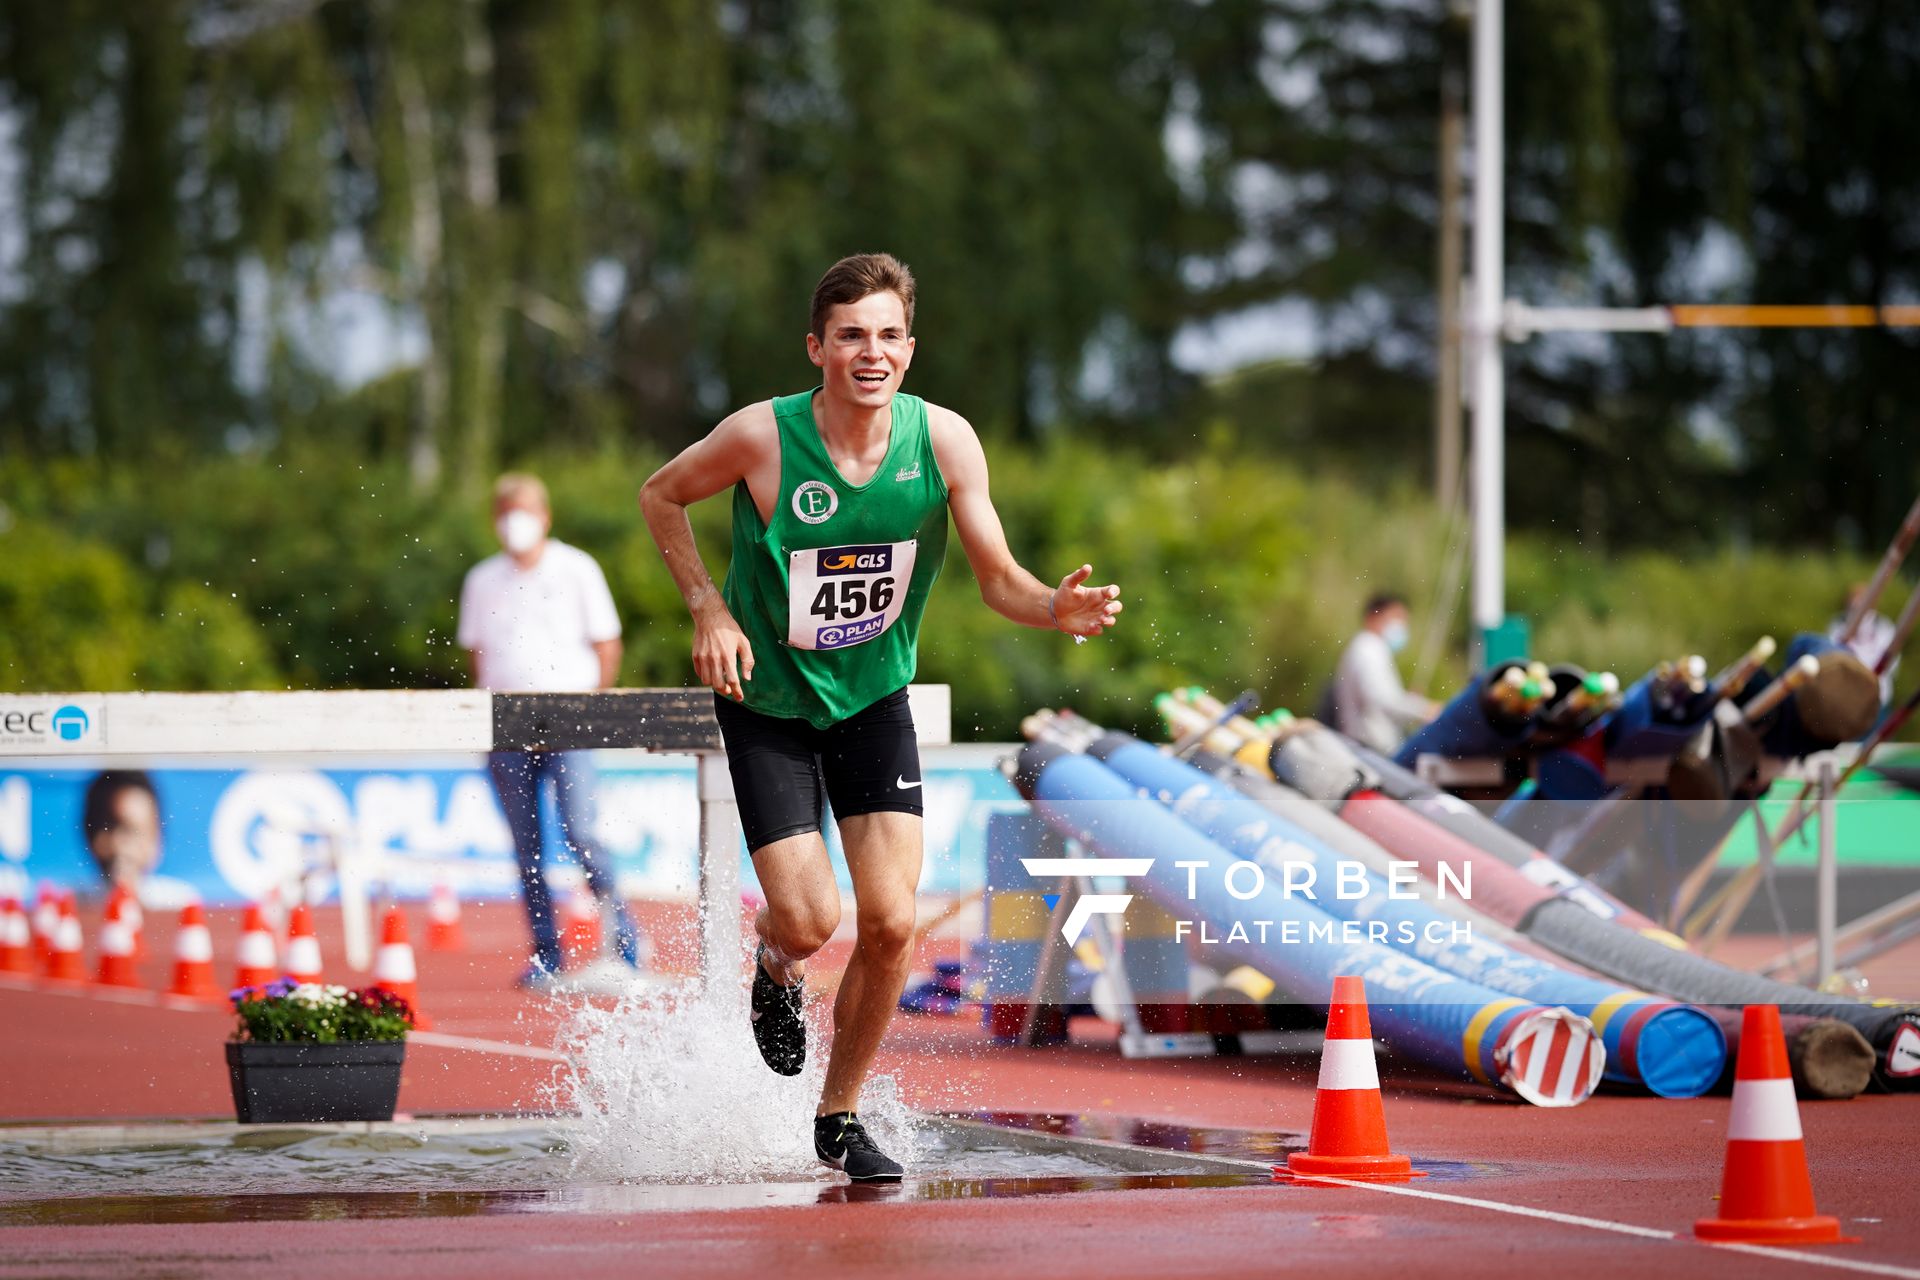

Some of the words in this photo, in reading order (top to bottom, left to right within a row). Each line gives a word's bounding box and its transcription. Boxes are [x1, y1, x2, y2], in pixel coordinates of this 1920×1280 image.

[804, 490, 827, 515] E
[856, 553, 886, 569] GLS
[810, 576, 895, 621] 456
[846, 618, 882, 638] PLAN
